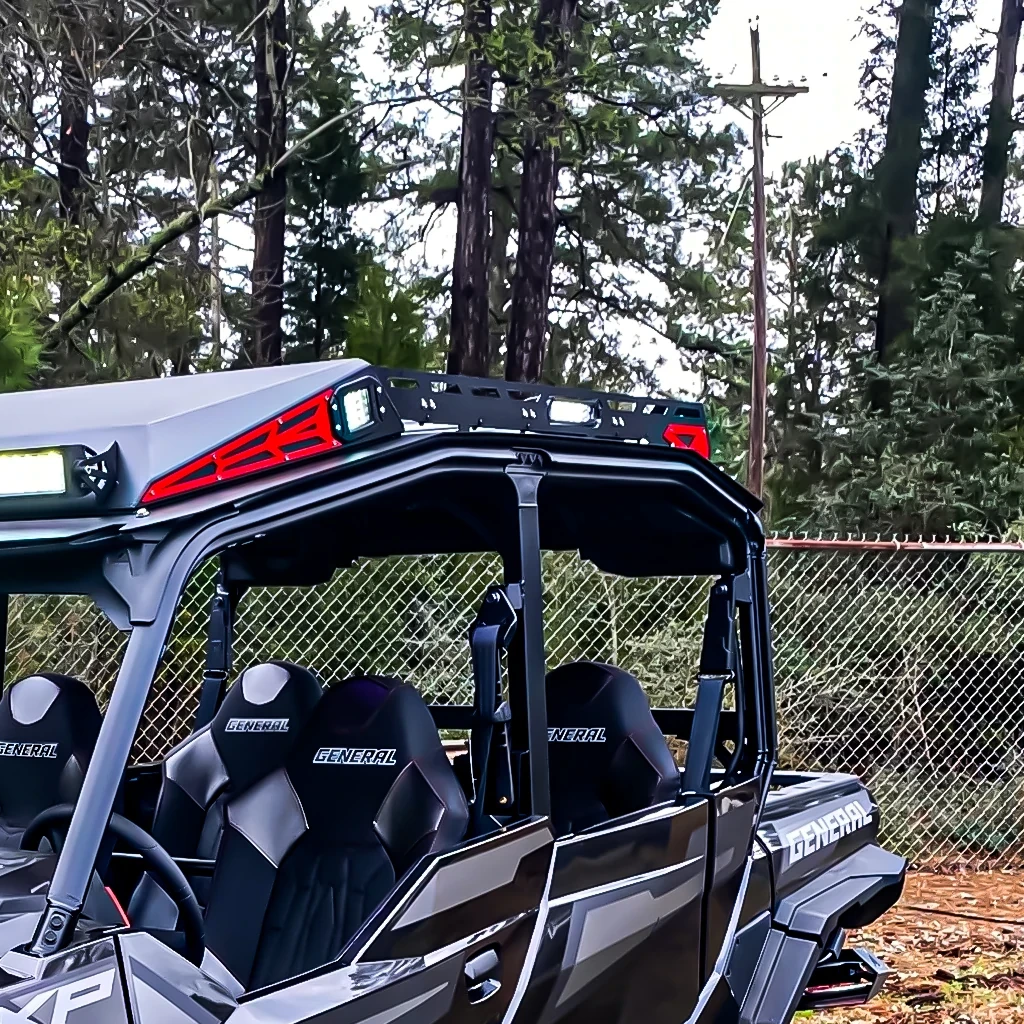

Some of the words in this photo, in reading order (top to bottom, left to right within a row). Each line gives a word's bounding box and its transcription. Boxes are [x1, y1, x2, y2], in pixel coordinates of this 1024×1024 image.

[225, 718, 289, 732] GENERAL
[313, 747, 397, 765] GENERAL
[786, 800, 873, 865] GENERAL
